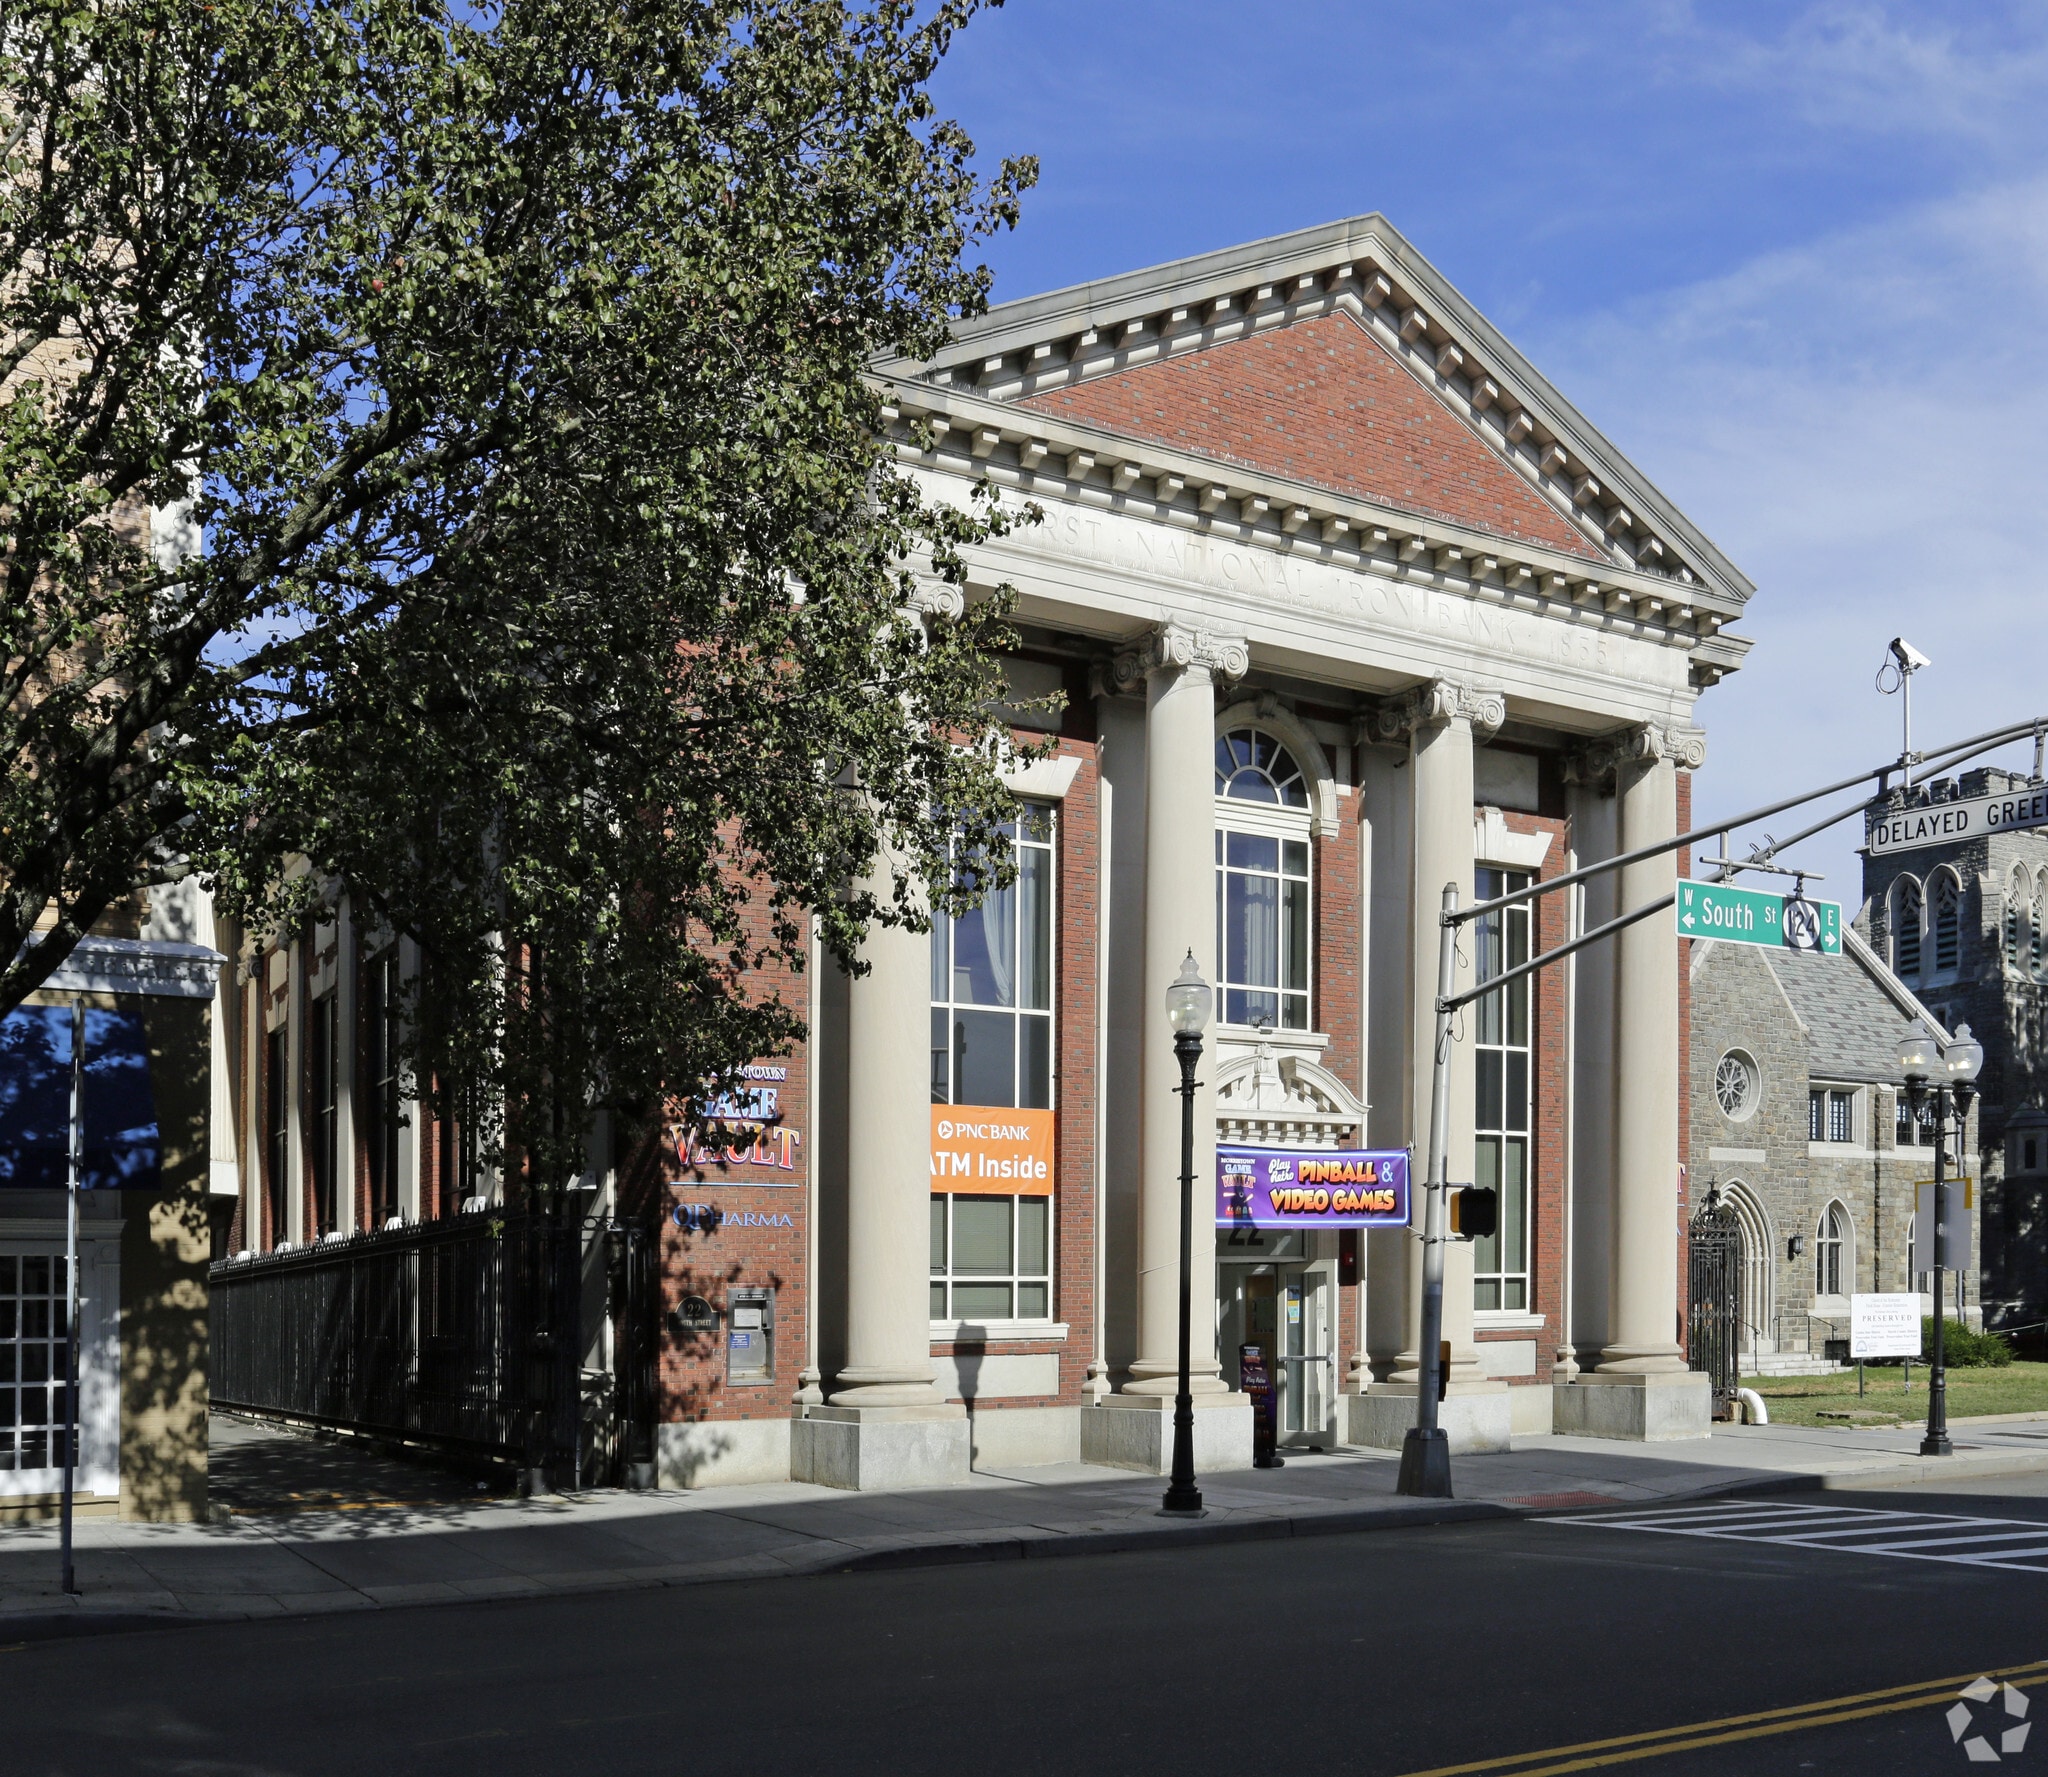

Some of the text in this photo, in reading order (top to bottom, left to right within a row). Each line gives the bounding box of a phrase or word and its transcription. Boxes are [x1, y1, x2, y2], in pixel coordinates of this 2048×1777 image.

[1136, 530, 1310, 599] NATIONAL
[1335, 577, 1414, 617] IRON
[1437, 602, 1516, 645] BANK
[1878, 795, 2048, 845] DELAYED GREE
[1684, 887, 1694, 906] W
[1702, 897, 1777, 930] South St
[1788, 908, 1816, 938] 124
[1827, 909, 1834, 927] E
[669, 1121, 800, 1170] VAULT
[978, 1152, 1047, 1179] Inside
[1268, 1158, 1291, 1174] Play
[1270, 1169, 1295, 1184] Retro
[1298, 1159, 1394, 1185] PINBALL &
[1269, 1187, 1397, 1214] VIDEO GAMES
[687, 1303, 702, 1317] 22
[1862, 1314, 1912, 1322] PRESERVED
